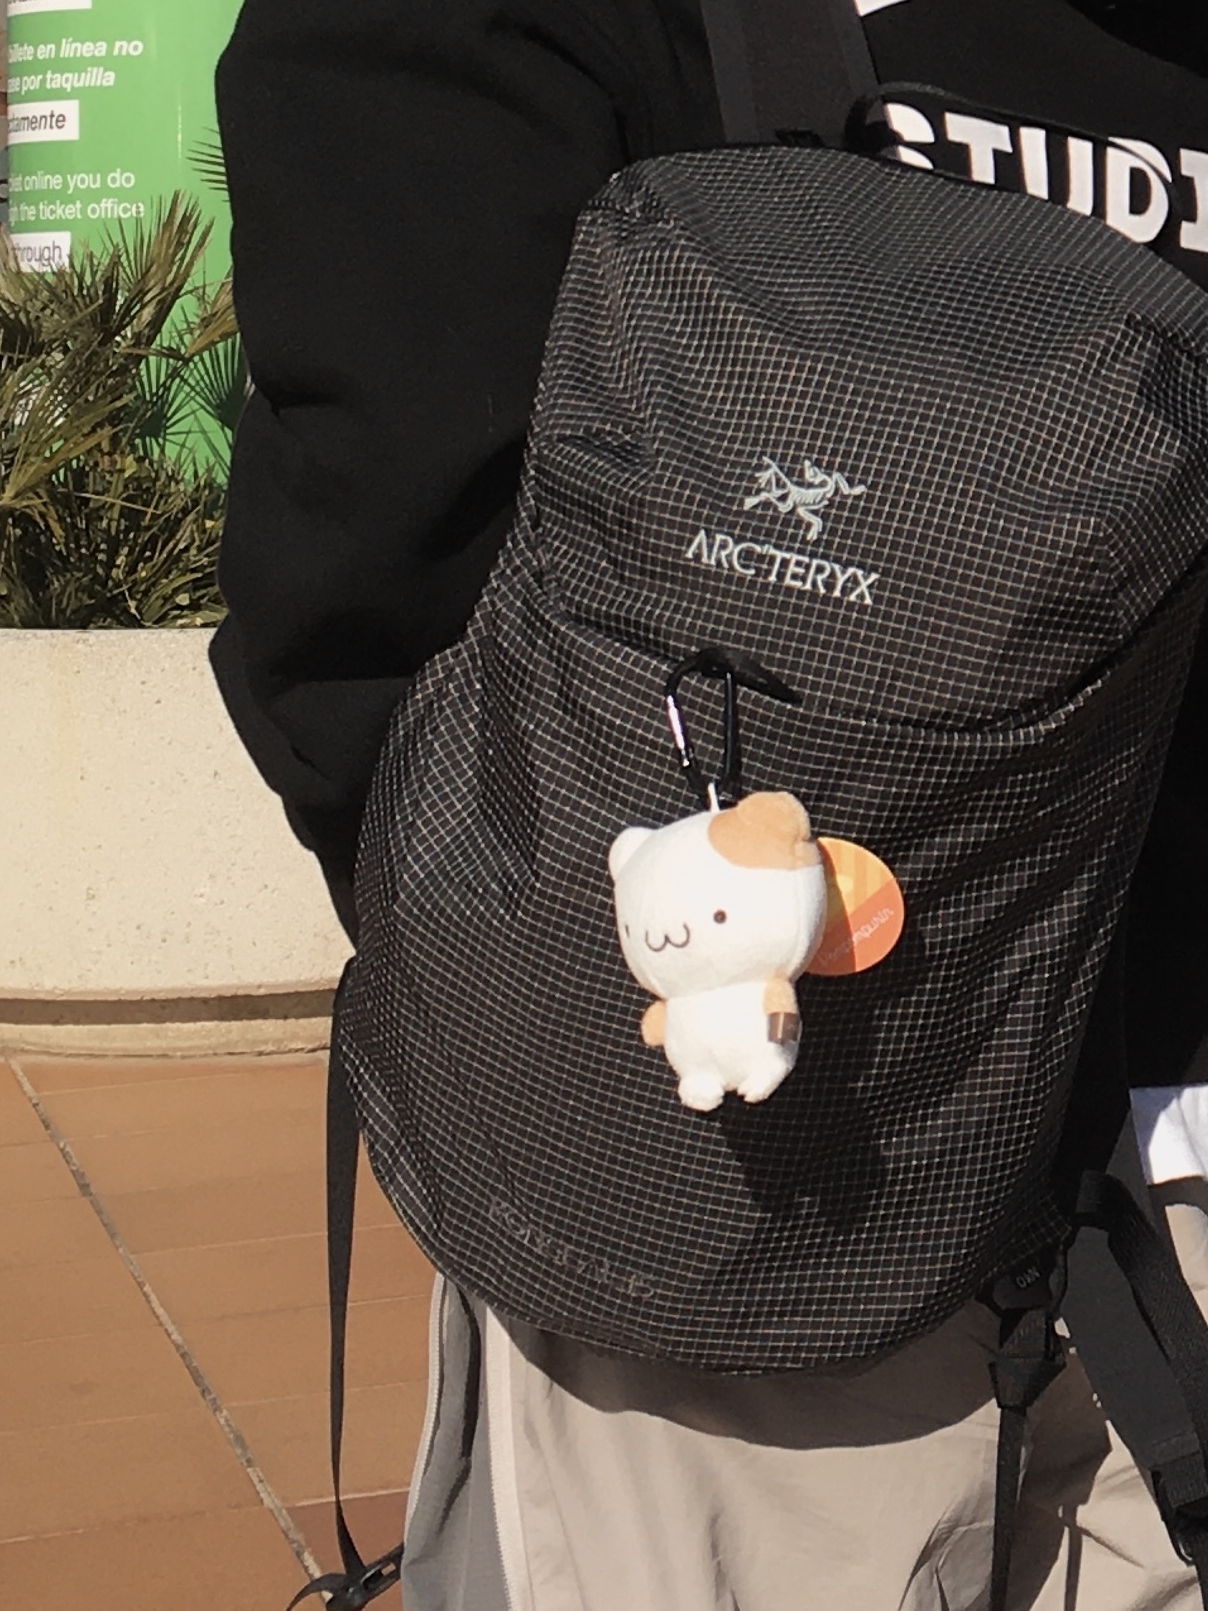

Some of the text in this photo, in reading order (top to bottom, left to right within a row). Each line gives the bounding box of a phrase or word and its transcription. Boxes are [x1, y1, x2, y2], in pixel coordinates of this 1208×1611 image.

[37, 43, 56, 60] en
[60, 37, 108, 58] línea
[112, 39, 144, 57] no
[21, 74, 43, 95] por
[45, 66, 116, 92] taquilla
[67, 173, 101, 194] you
[107, 167, 136, 189] do
[39, 199, 82, 220] ticket
[87, 197, 145, 219] office
